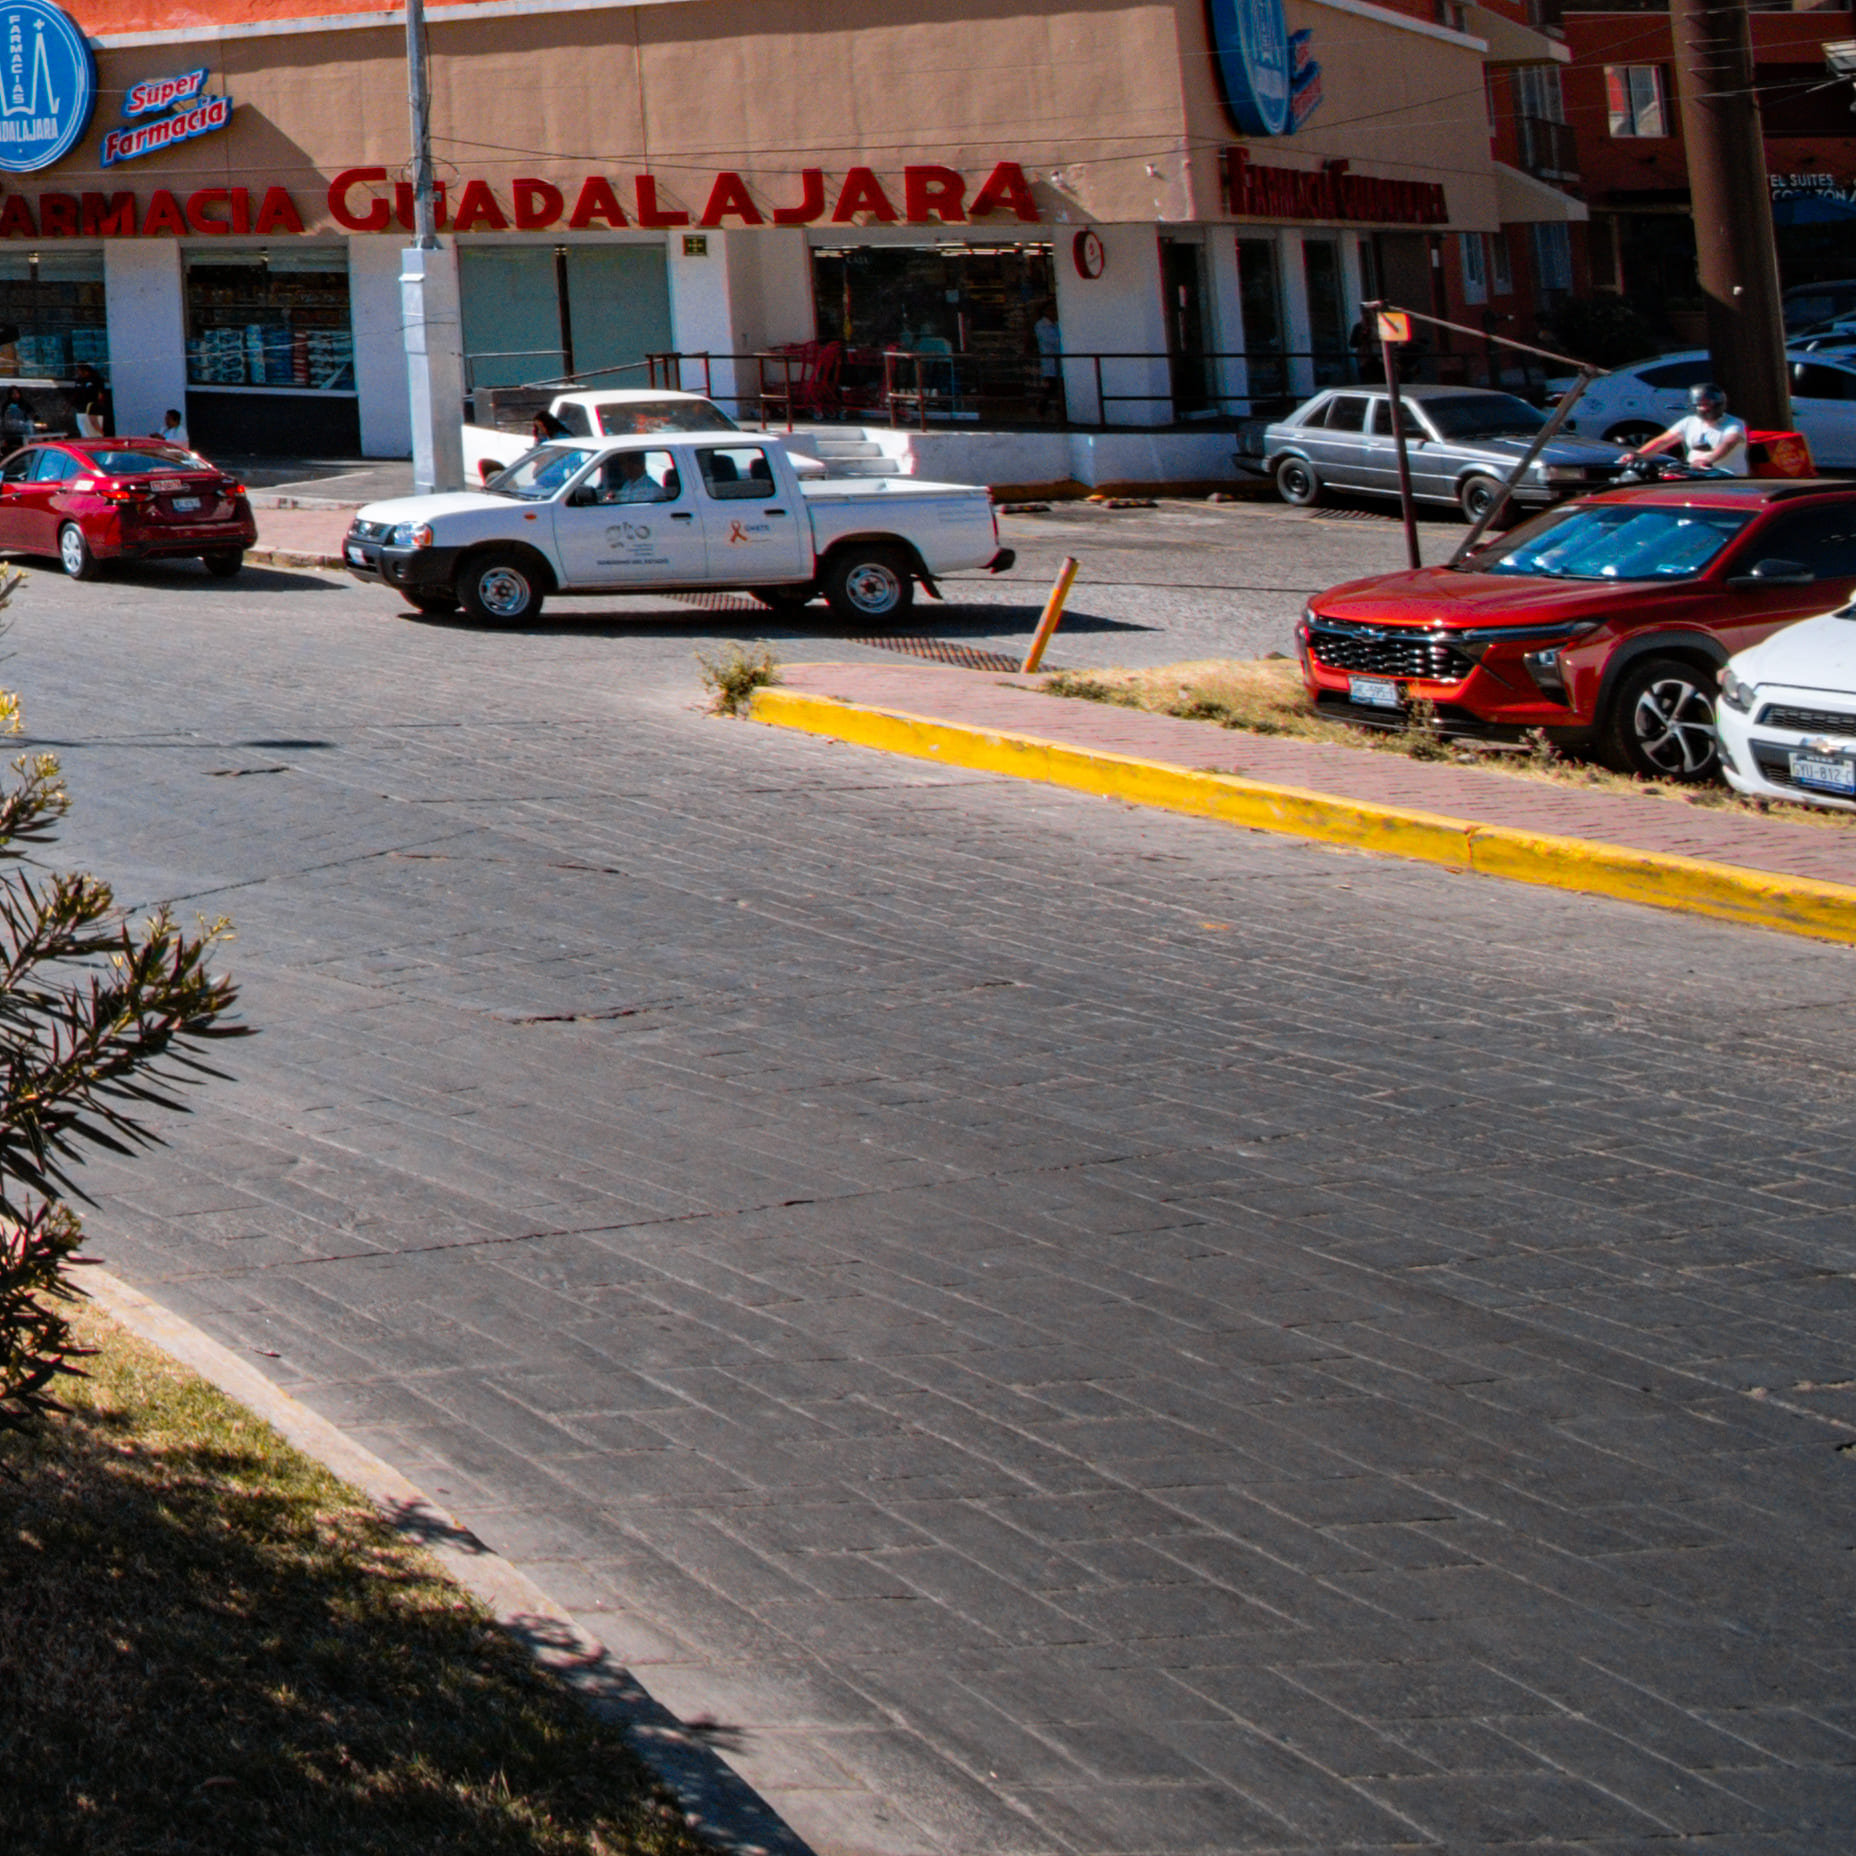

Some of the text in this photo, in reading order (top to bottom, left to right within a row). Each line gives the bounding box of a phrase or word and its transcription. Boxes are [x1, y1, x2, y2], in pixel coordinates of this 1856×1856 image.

[8, 15, 24, 104] FARMACIAS
[129, 74, 200, 111] Super
[105, 97, 225, 161] Farmacia
[327, 162, 1039, 231] GUADALAJARA
[1790, 174, 1833, 187] SUITES
